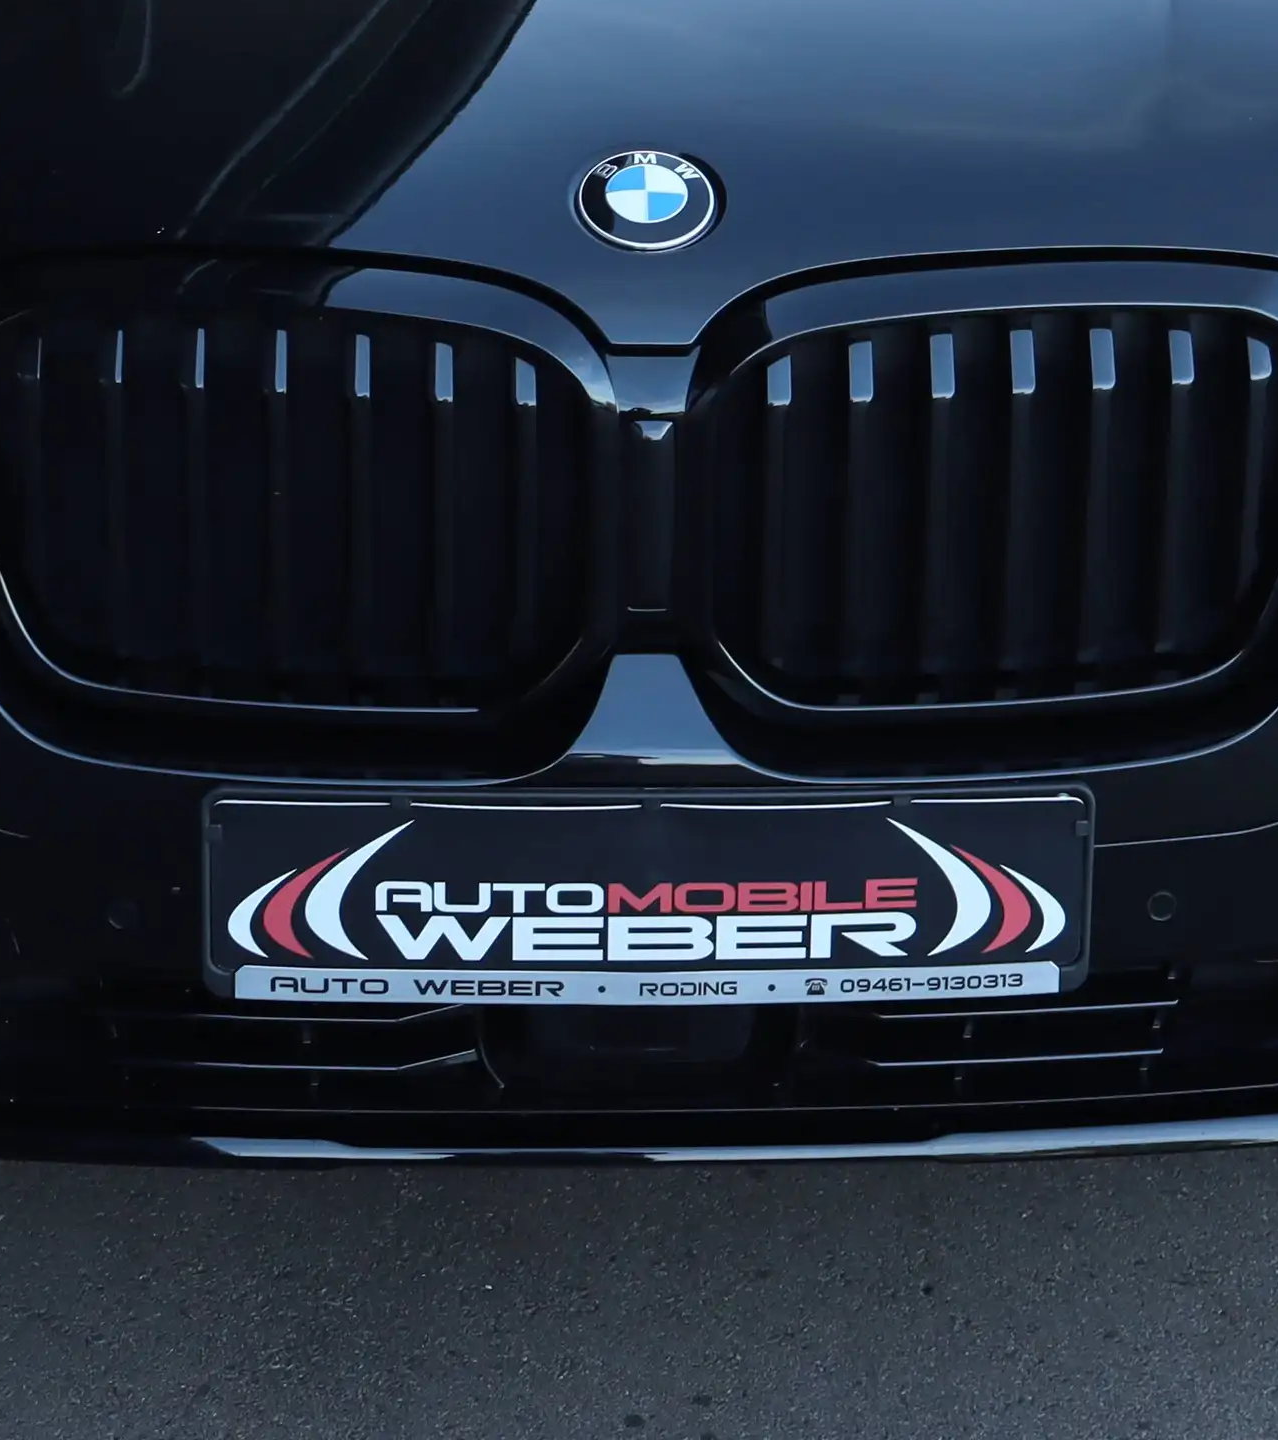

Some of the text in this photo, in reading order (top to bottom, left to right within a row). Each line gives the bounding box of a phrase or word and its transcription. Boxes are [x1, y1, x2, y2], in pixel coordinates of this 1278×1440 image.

[596, 152, 701, 180] BMW
[374, 877, 919, 915] AUTOMOBILE
[375, 910, 918, 962] WEBER
[270, 972, 1024, 998] AUTO WEBER RODING 09461-9130313
